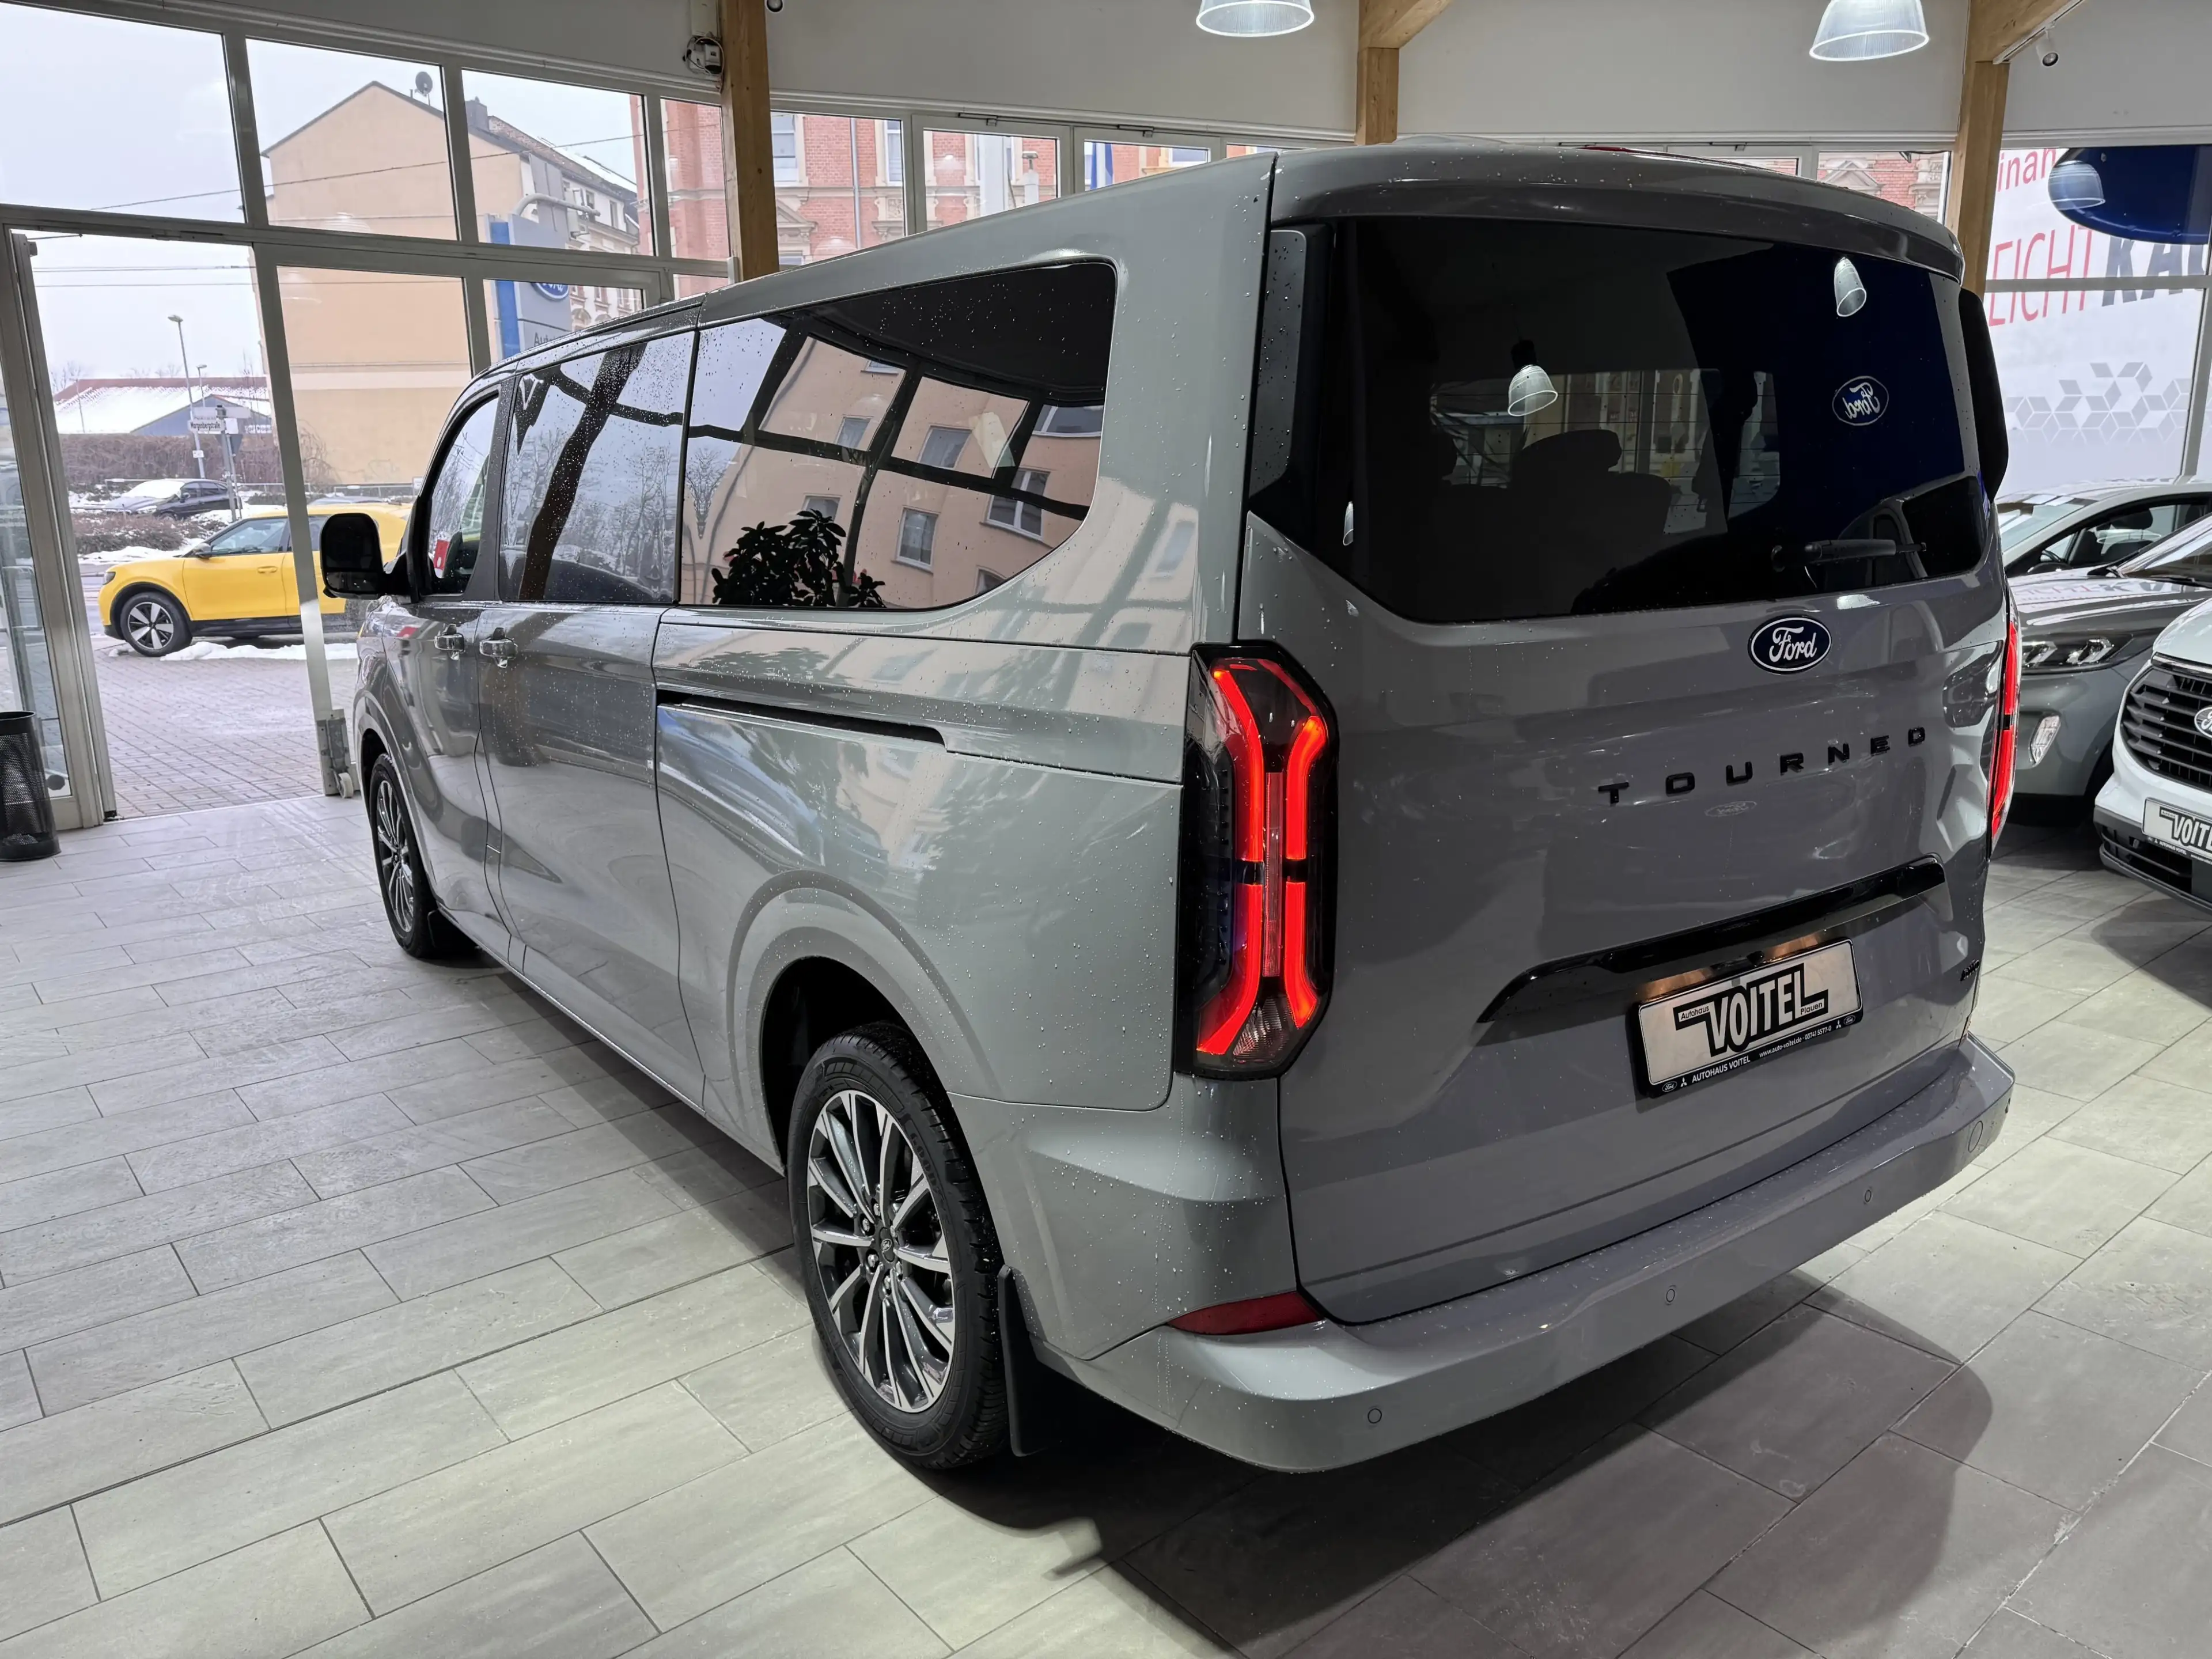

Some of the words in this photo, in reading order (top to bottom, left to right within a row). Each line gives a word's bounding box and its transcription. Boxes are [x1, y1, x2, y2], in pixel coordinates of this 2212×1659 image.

[1998, 147, 2056, 192] inan
[1989, 224, 2093, 327] EICHT
[1769, 626, 1817, 662] Ford
[1599, 727, 1926, 804] TOURNEO
[1680, 1005, 1710, 1020] Autohaus
[1709, 970, 1803, 1050] VOITEL
[1800, 1002, 1823, 1015] Plauen
[1759, 1037, 1802, 1058] www.auto-voitel.de
[1817, 1025, 1832, 1036] 5577-0
[1692, 1063, 1728, 1084] AUTOHAUS
[1729, 1055, 1751, 1070] VOITEL
